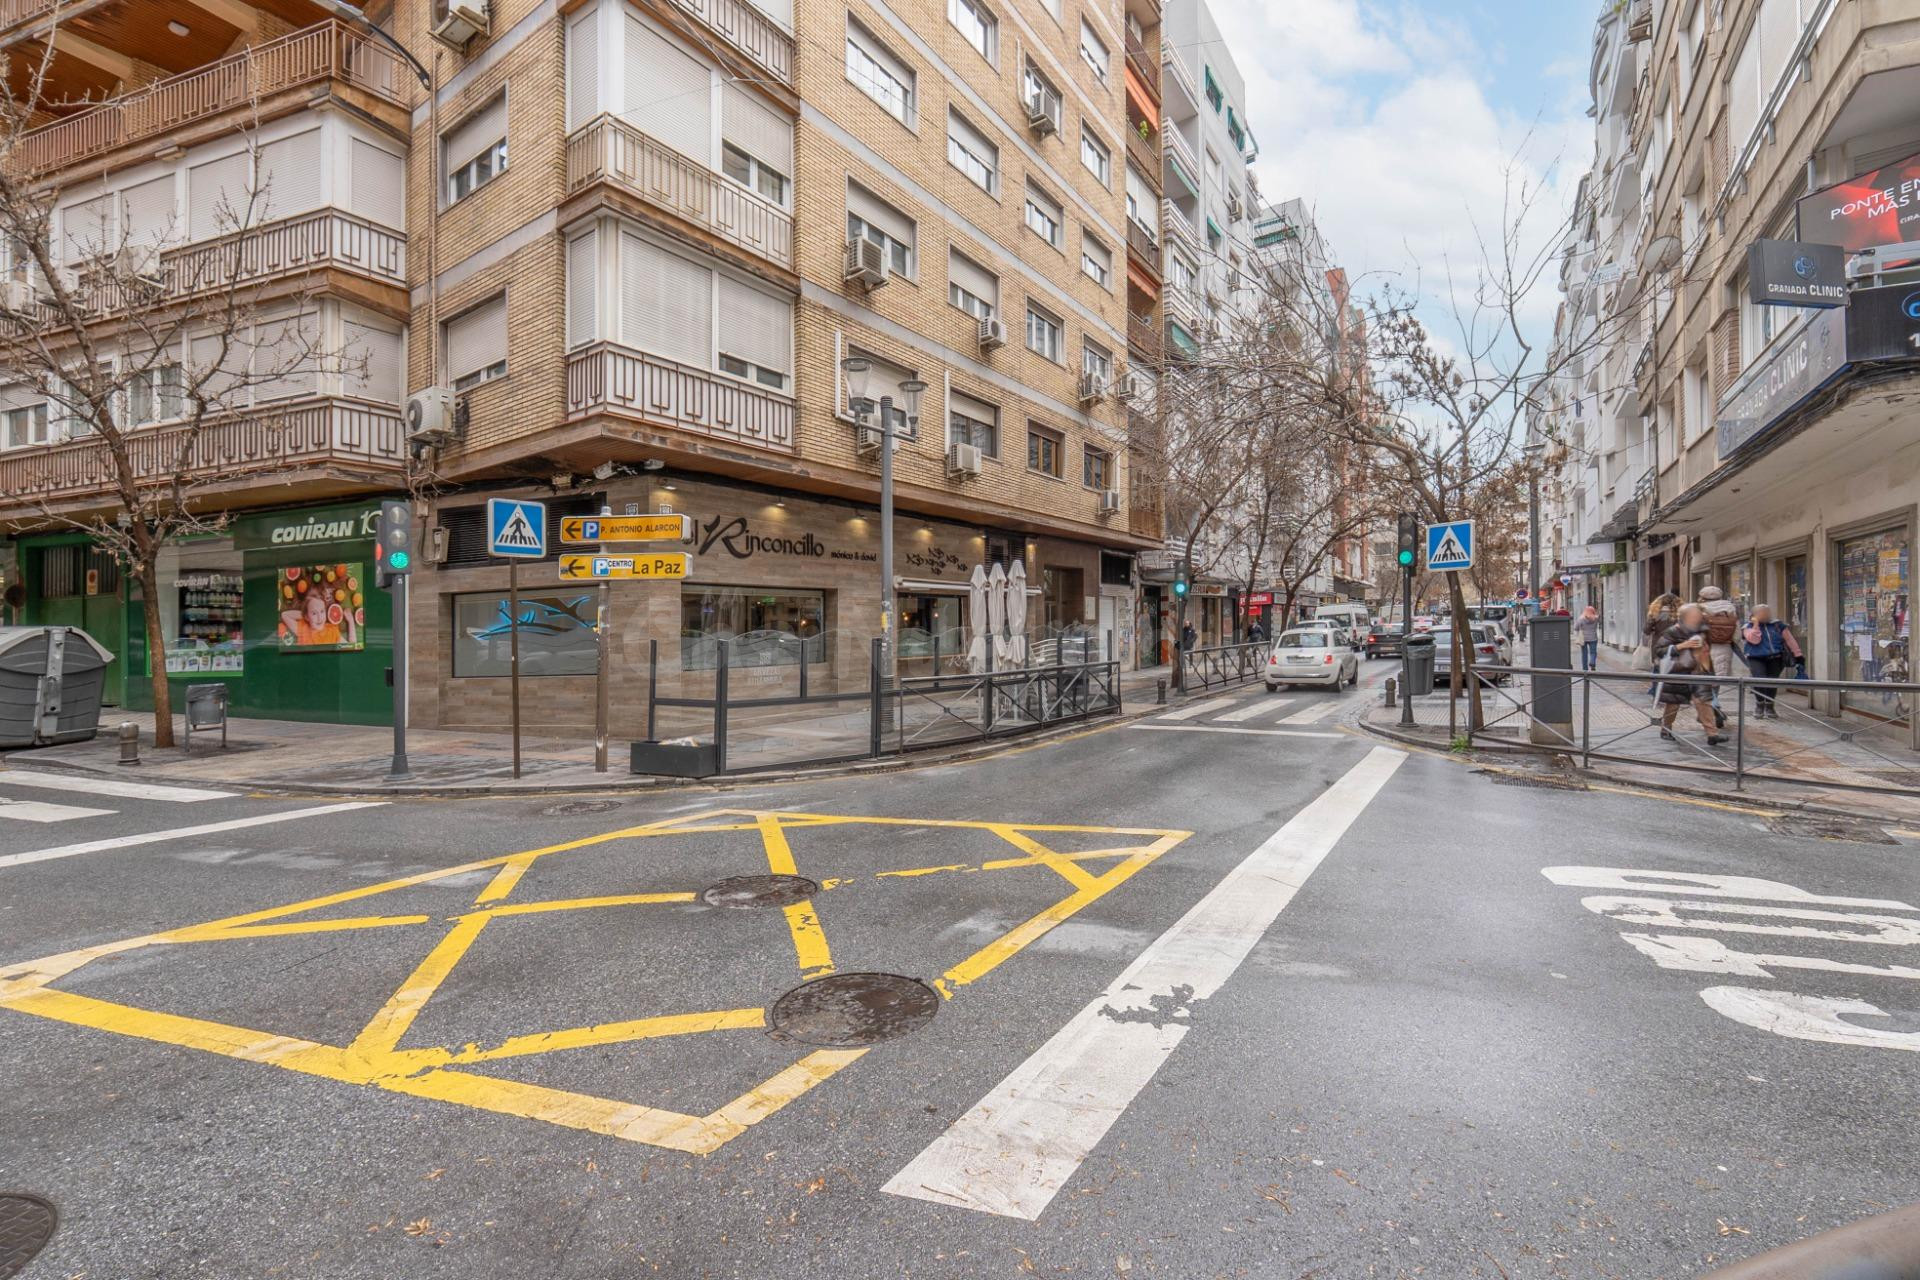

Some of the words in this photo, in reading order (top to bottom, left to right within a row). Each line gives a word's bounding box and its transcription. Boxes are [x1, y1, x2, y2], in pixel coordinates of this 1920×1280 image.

[1831, 187, 1894, 220] PONTE
[1768, 283, 1807, 295] GRANADA
[1809, 284, 1844, 298] CLINIC
[1770, 340, 1808, 396] CLINIC
[610, 524, 643, 534] ANTONIO
[645, 523, 680, 533] ALARCON
[608, 559, 632, 568] CENTRO
[632, 560, 649, 575] La
[654, 560, 681, 575] Paz
